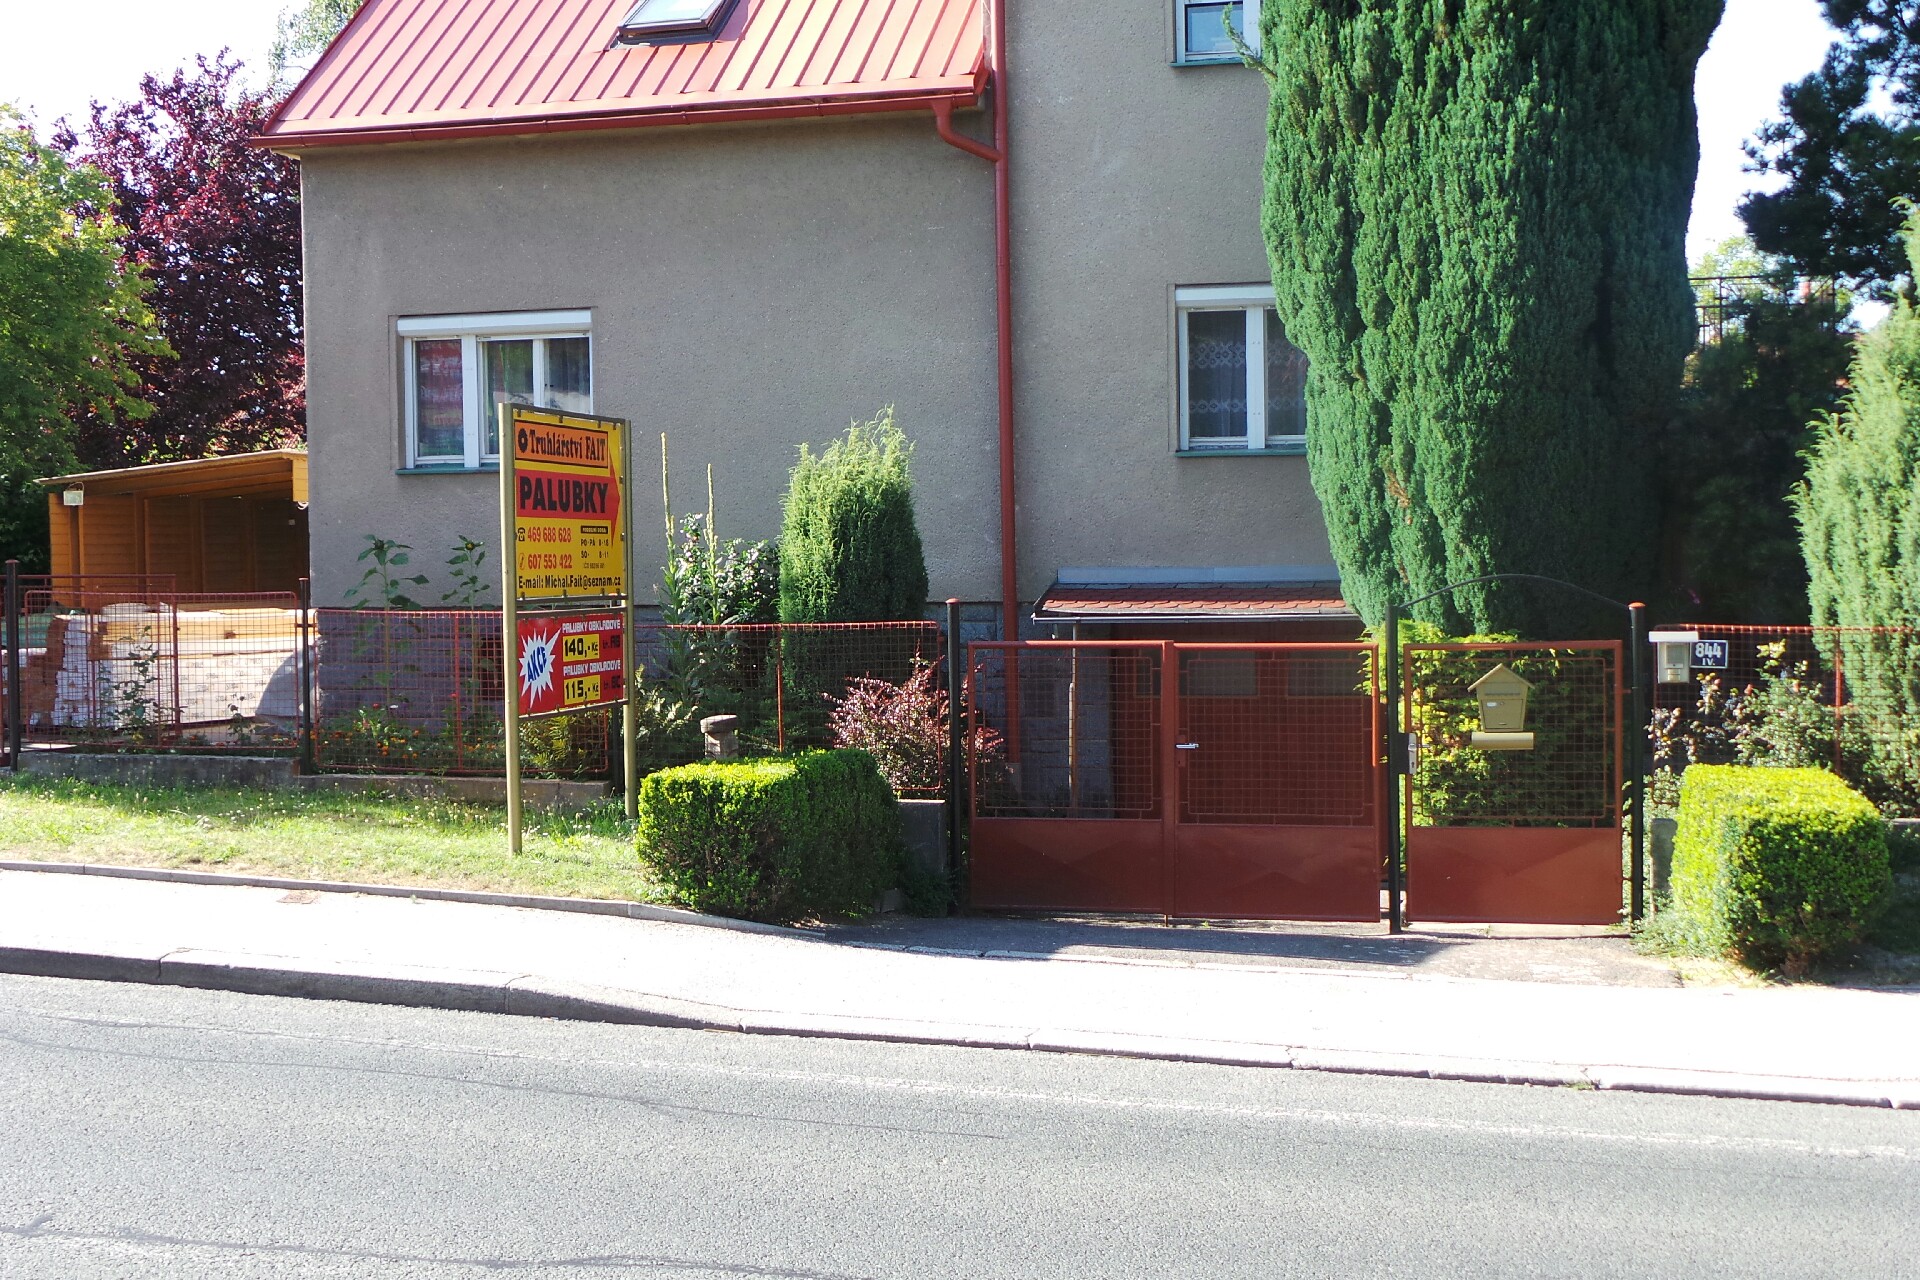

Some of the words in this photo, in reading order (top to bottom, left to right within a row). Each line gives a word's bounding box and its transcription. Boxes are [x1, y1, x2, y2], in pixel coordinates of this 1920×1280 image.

[529, 429, 583, 458] Truhlářství
[585, 437, 606, 461] FAIT
[519, 476, 608, 513] PALUBKY
[527, 527, 541, 543] 469
[558, 528, 572, 543] 628
[527, 554, 542, 570] 607
[543, 554, 557, 569] 553
[559, 553, 573, 569] 422
[518, 576, 544, 589] E-mail:
[1695, 642, 1722, 658] 844
[527, 646, 547, 682] AKCE
